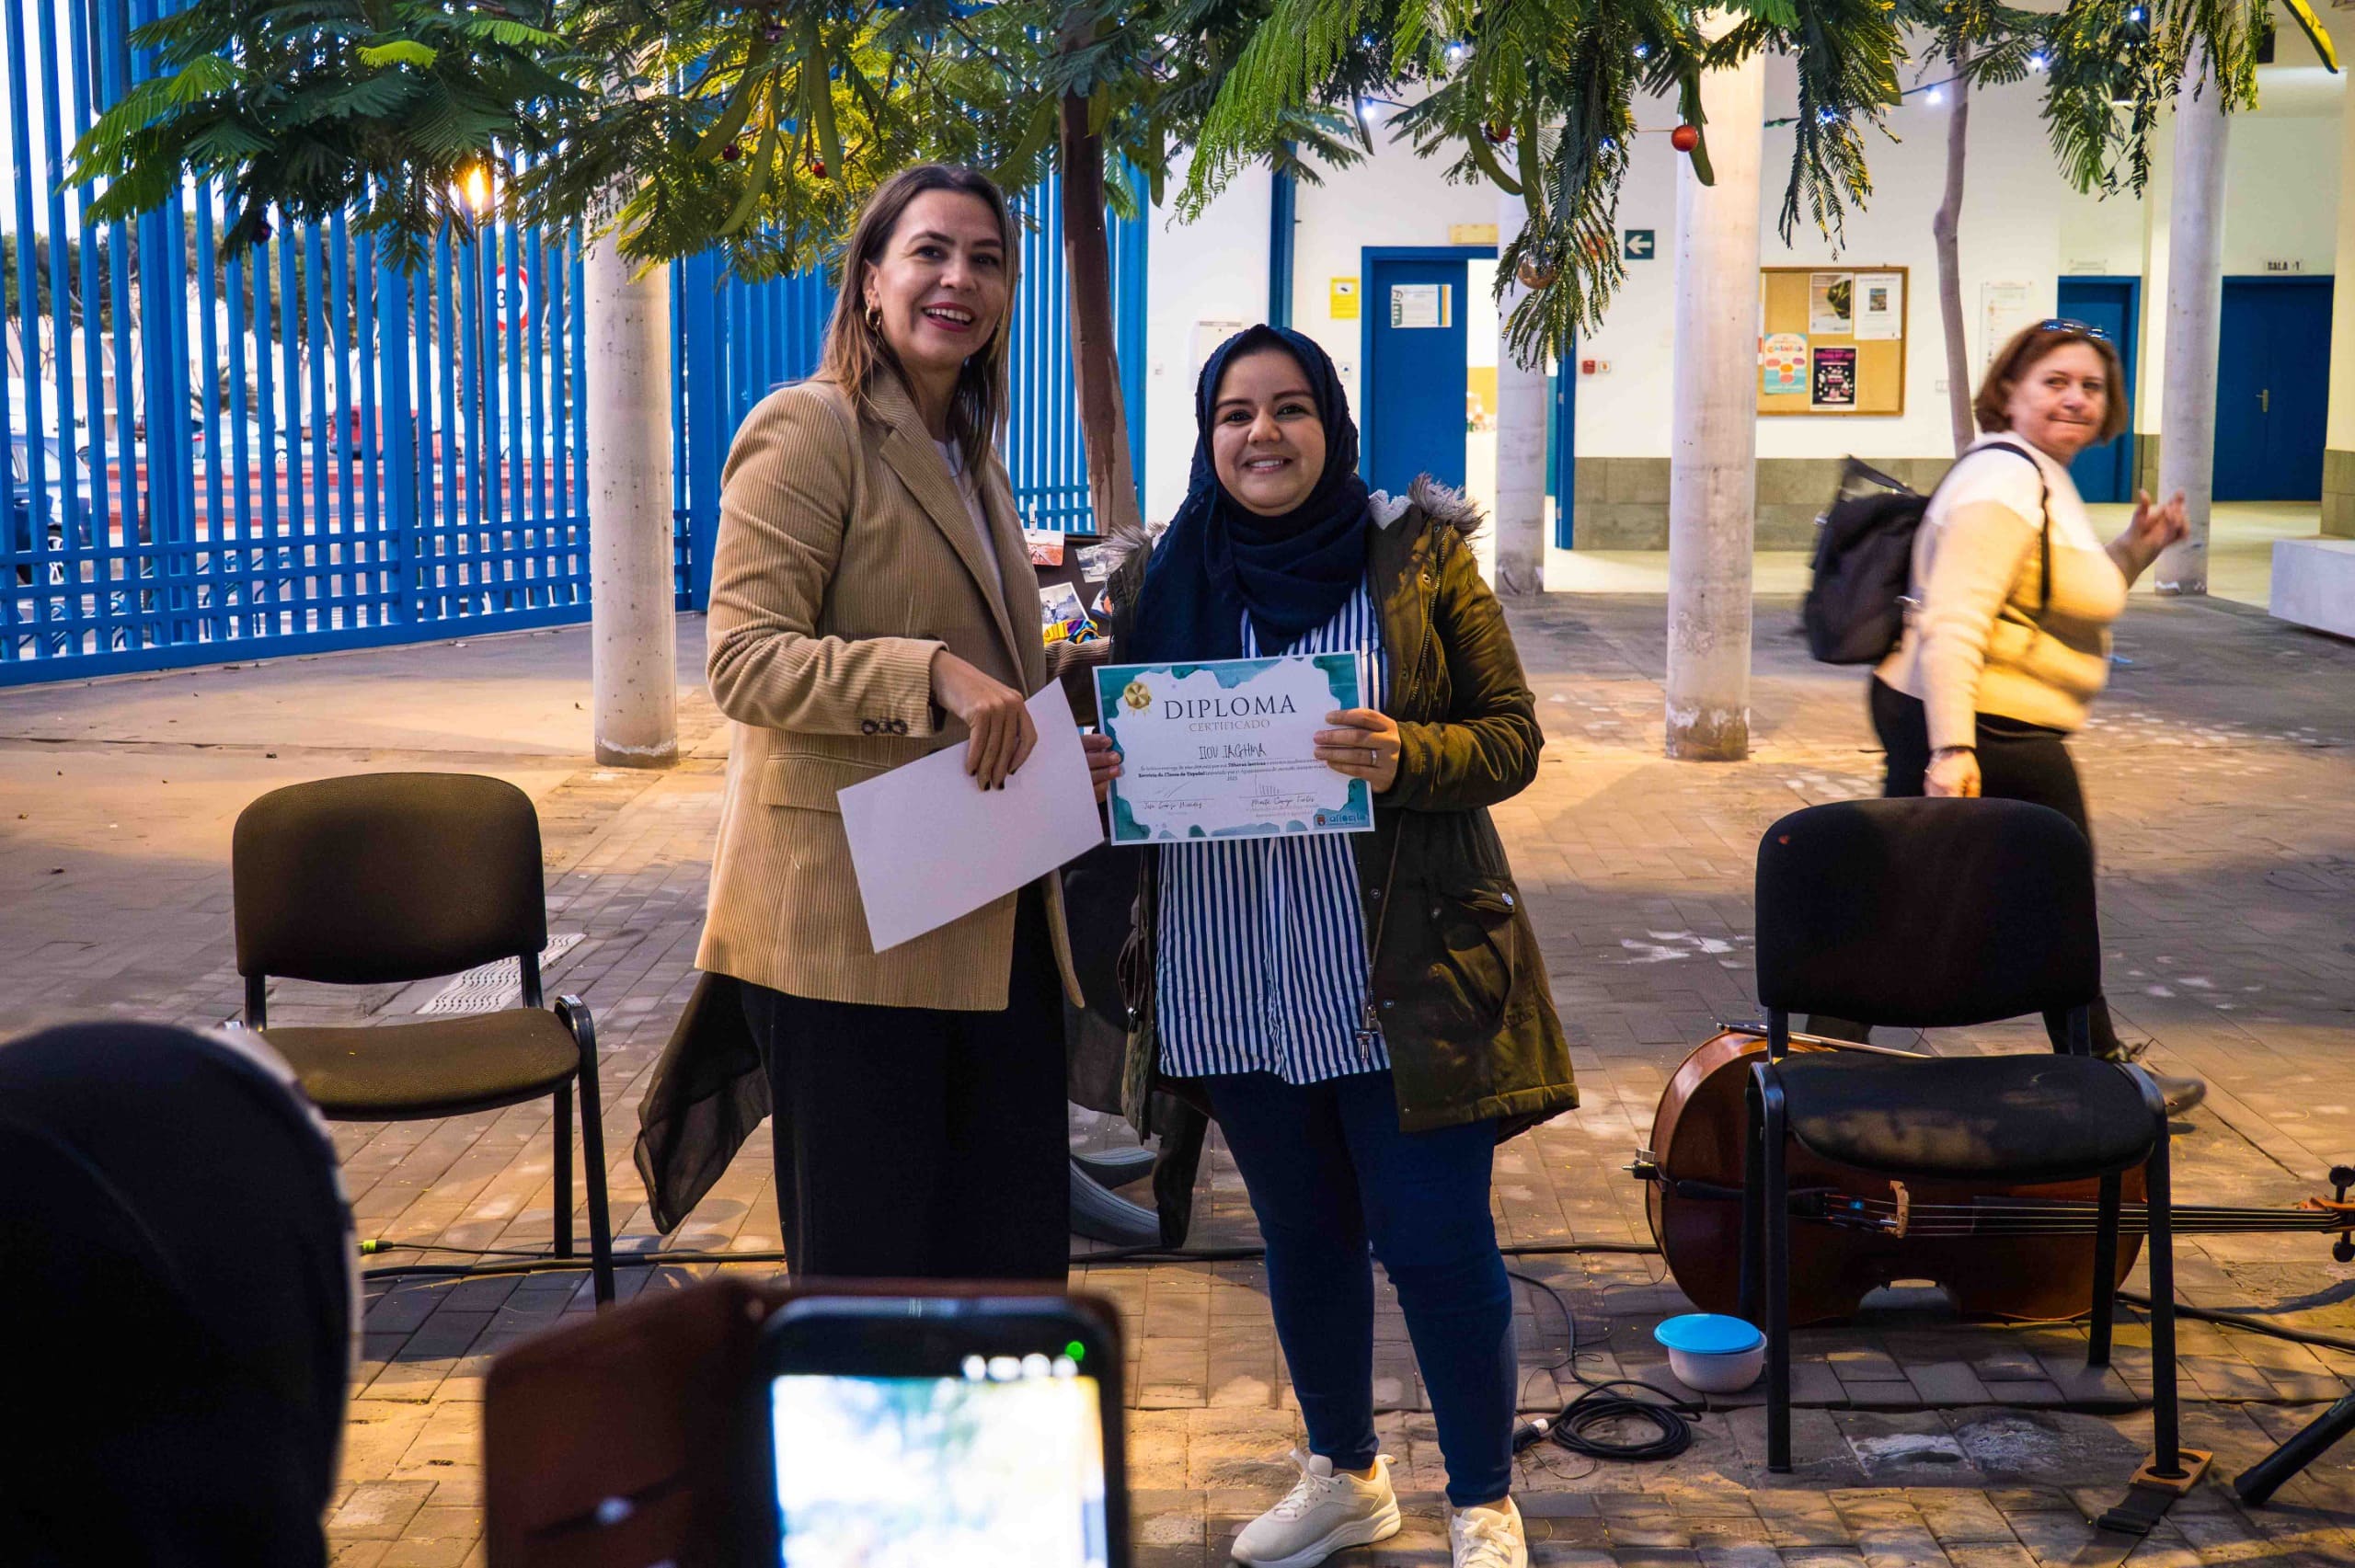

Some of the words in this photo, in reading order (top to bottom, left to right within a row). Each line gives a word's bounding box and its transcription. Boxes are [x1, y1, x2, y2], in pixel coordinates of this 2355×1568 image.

[2267, 261, 2289, 271] SALA
[1164, 693, 1297, 720] DIPLOMA
[1189, 719, 1270, 732] CERTIFICADO
